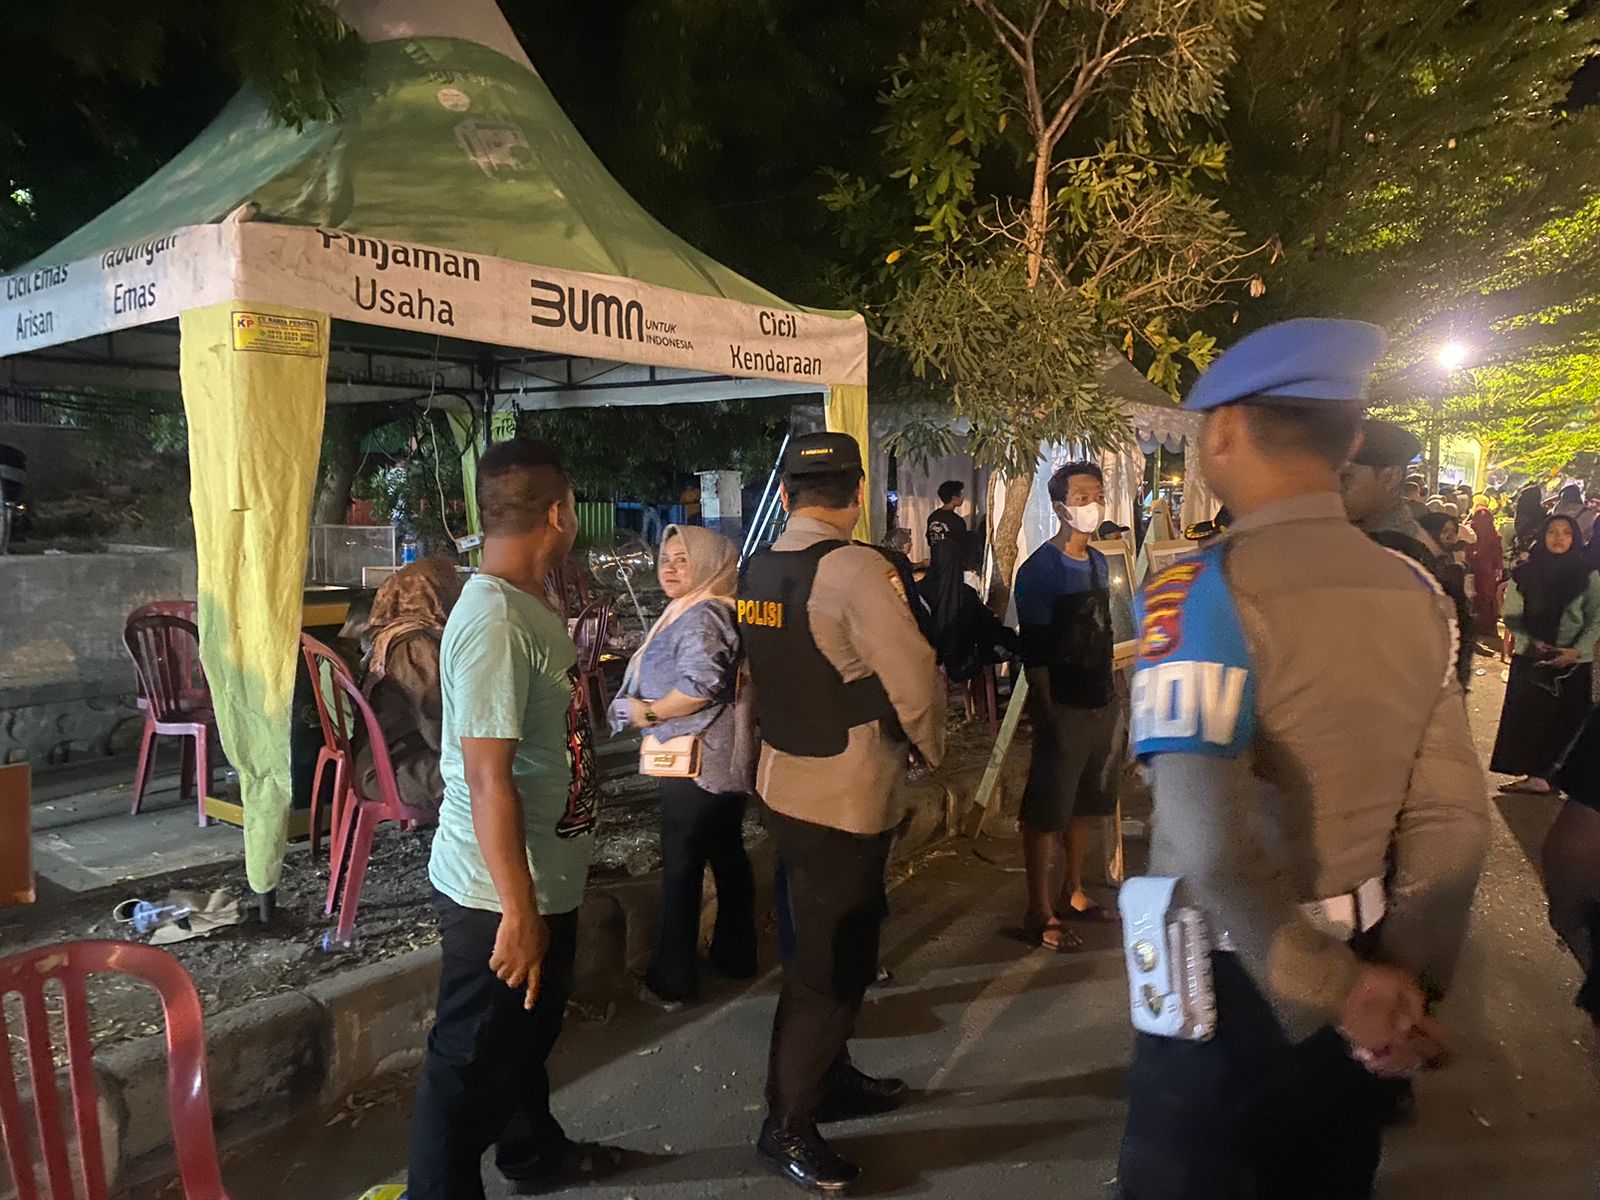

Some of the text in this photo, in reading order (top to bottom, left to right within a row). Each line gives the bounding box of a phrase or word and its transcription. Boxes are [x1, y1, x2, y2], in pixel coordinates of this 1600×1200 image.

[114, 281, 156, 315] Emas
[355, 275, 455, 327] Usaha
[530, 279, 644, 343] BUMN
[16, 310, 54, 340] Arisan
[645, 319, 677, 334] UNTUK
[759, 310, 798, 339] Cicil
[645, 334, 694, 351] INDONESIA
[729, 344, 822, 376] Kendaraan
[737, 600, 783, 628] POLISI
